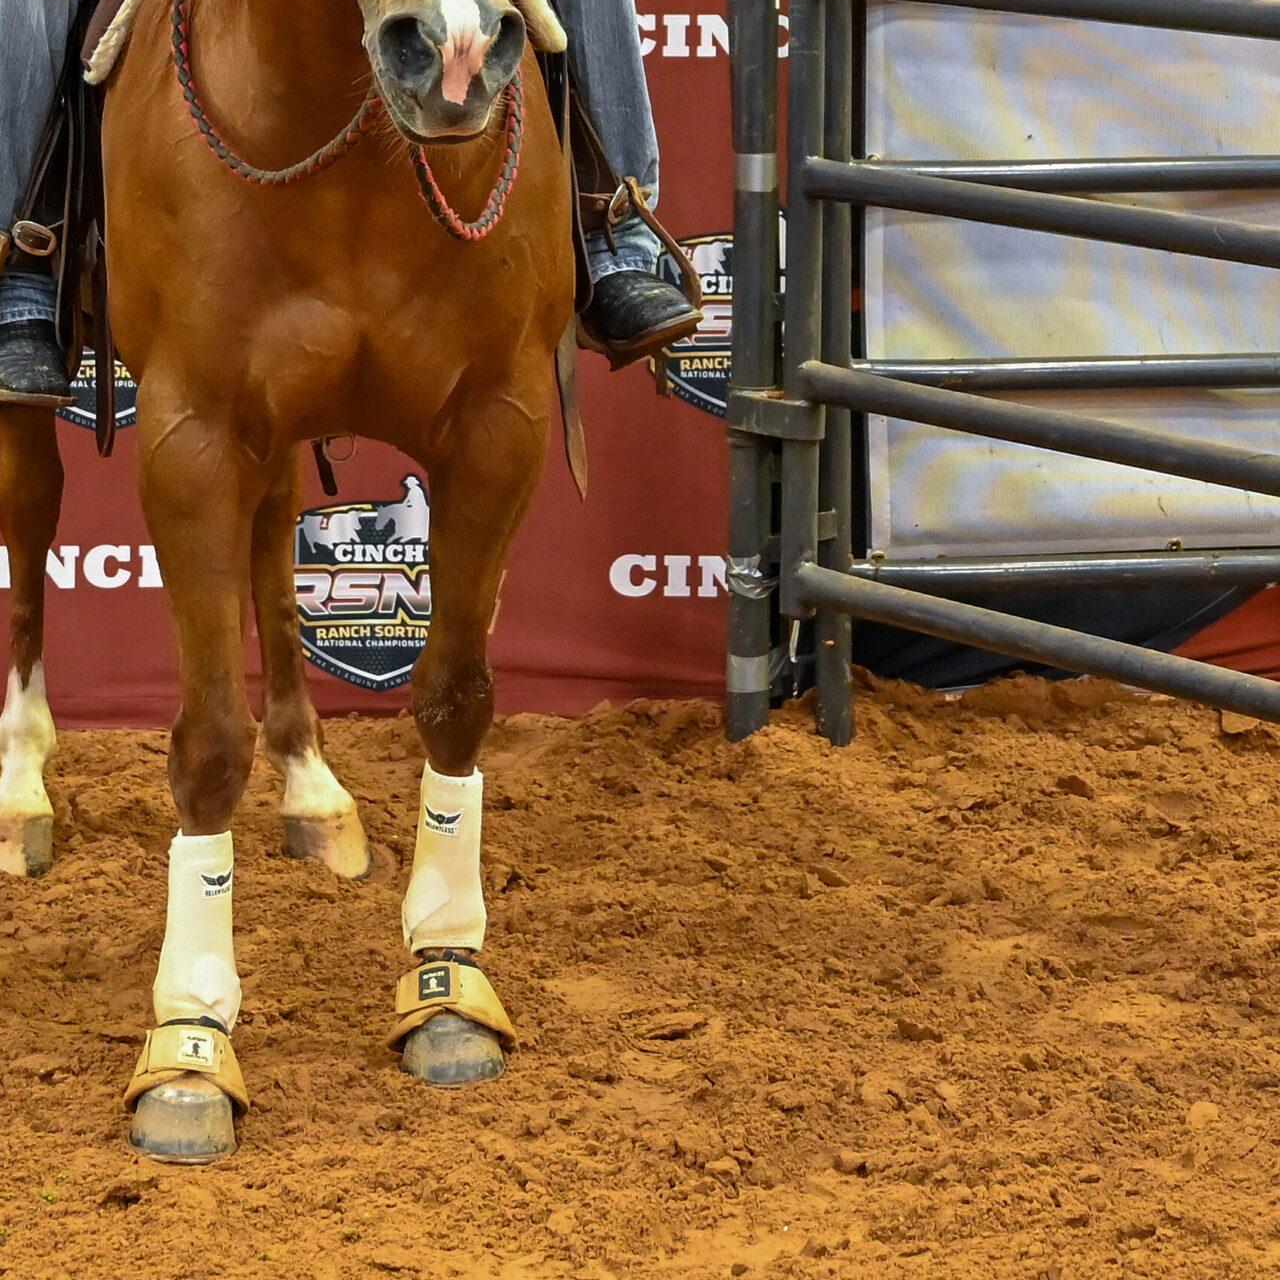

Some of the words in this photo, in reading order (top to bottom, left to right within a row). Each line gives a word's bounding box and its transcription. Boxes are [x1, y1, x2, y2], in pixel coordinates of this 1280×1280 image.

[680, 370, 727, 378] NATIONAL
[334, 544, 425, 562] CINCH
[609, 553, 729, 598] CIN
[294, 572, 432, 615] RSN
[315, 626, 371, 639] RANCH
[374, 625, 429, 638] SORTIN
[316, 639, 363, 648] NATIONAL
[366, 639, 426, 648] CHAMPIONSH
[384, 673, 411, 688] FAMIL
